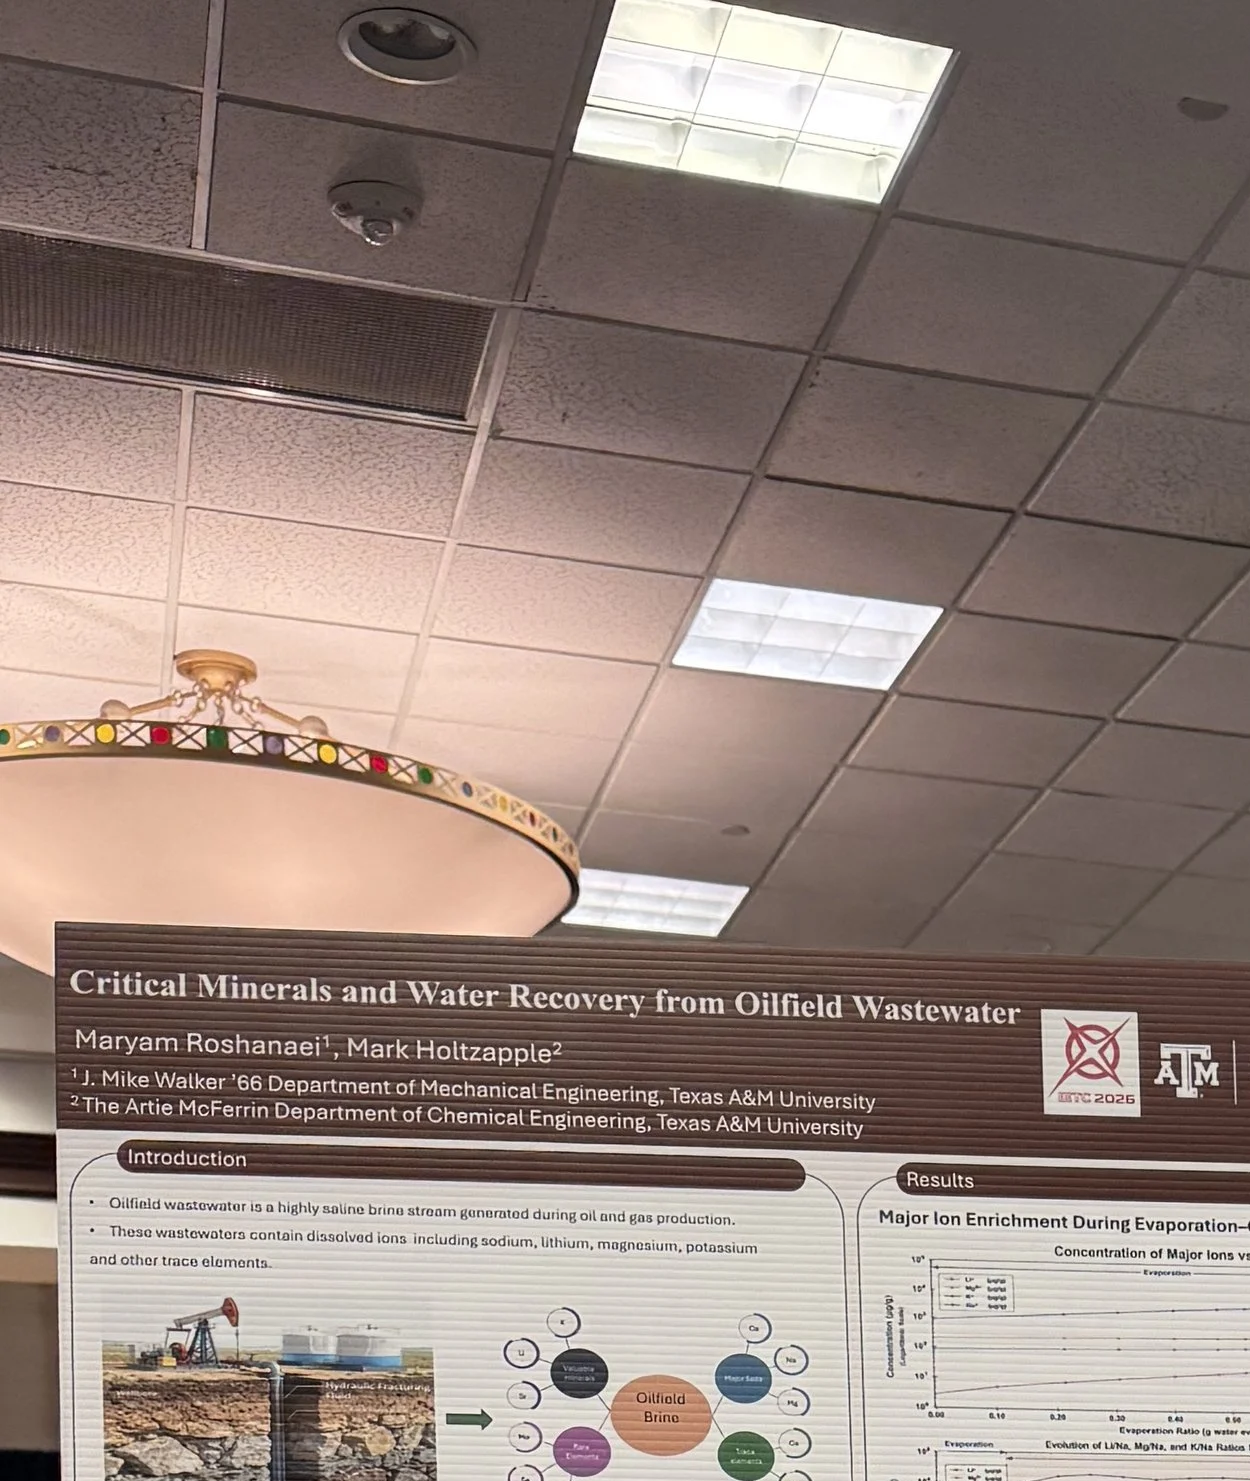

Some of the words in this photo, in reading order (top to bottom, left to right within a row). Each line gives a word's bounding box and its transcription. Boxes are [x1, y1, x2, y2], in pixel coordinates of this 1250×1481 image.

[70, 969, 187, 997] Critical
[197, 973, 332, 1002] Minerals
[341, 980, 397, 1004] and
[405, 980, 500, 1007] Water
[508, 983, 646, 1019] Recovery
[655, 988, 725, 1015] from
[734, 991, 843, 1019] Oilfield
[852, 995, 1021, 1025] Wastewater
[75, 1029, 178, 1055] Maryam
[347, 1037, 409, 1059] Mark
[102, 1070, 150, 1088] Mike
[154, 1071, 226, 1090] Walker
[268, 1074, 391, 1097] Department
[396, 1079, 416, 1096] of
[421, 1079, 538, 1099] Mechanical
[542, 1083, 665, 1107] Engineering,
[668, 1087, 724, 1105] Texas
[728, 1088, 774, 1107] A&M
[779, 1090, 876, 1114] University
[124, 1097, 173, 1116] Artie
[179, 1099, 269, 1118] McFerrin
[274, 1101, 398, 1123] Department
[402, 1106, 423, 1123] of
[427, 1106, 525, 1126] Chemical
[530, 1109, 652, 1134] Engineering,
[655, 1113, 711, 1132] Texas
[715, 1115, 761, 1133] A&M
[767, 1116, 864, 1140] University
[128, 1148, 247, 1167] Introduction
[906, 1171, 974, 1189] Results
[879, 1209, 930, 1228] Major
[934, 1211, 961, 1226] Ion
[966, 1212, 1068, 1229] Enrichment
[1073, 1215, 1131, 1234] During
